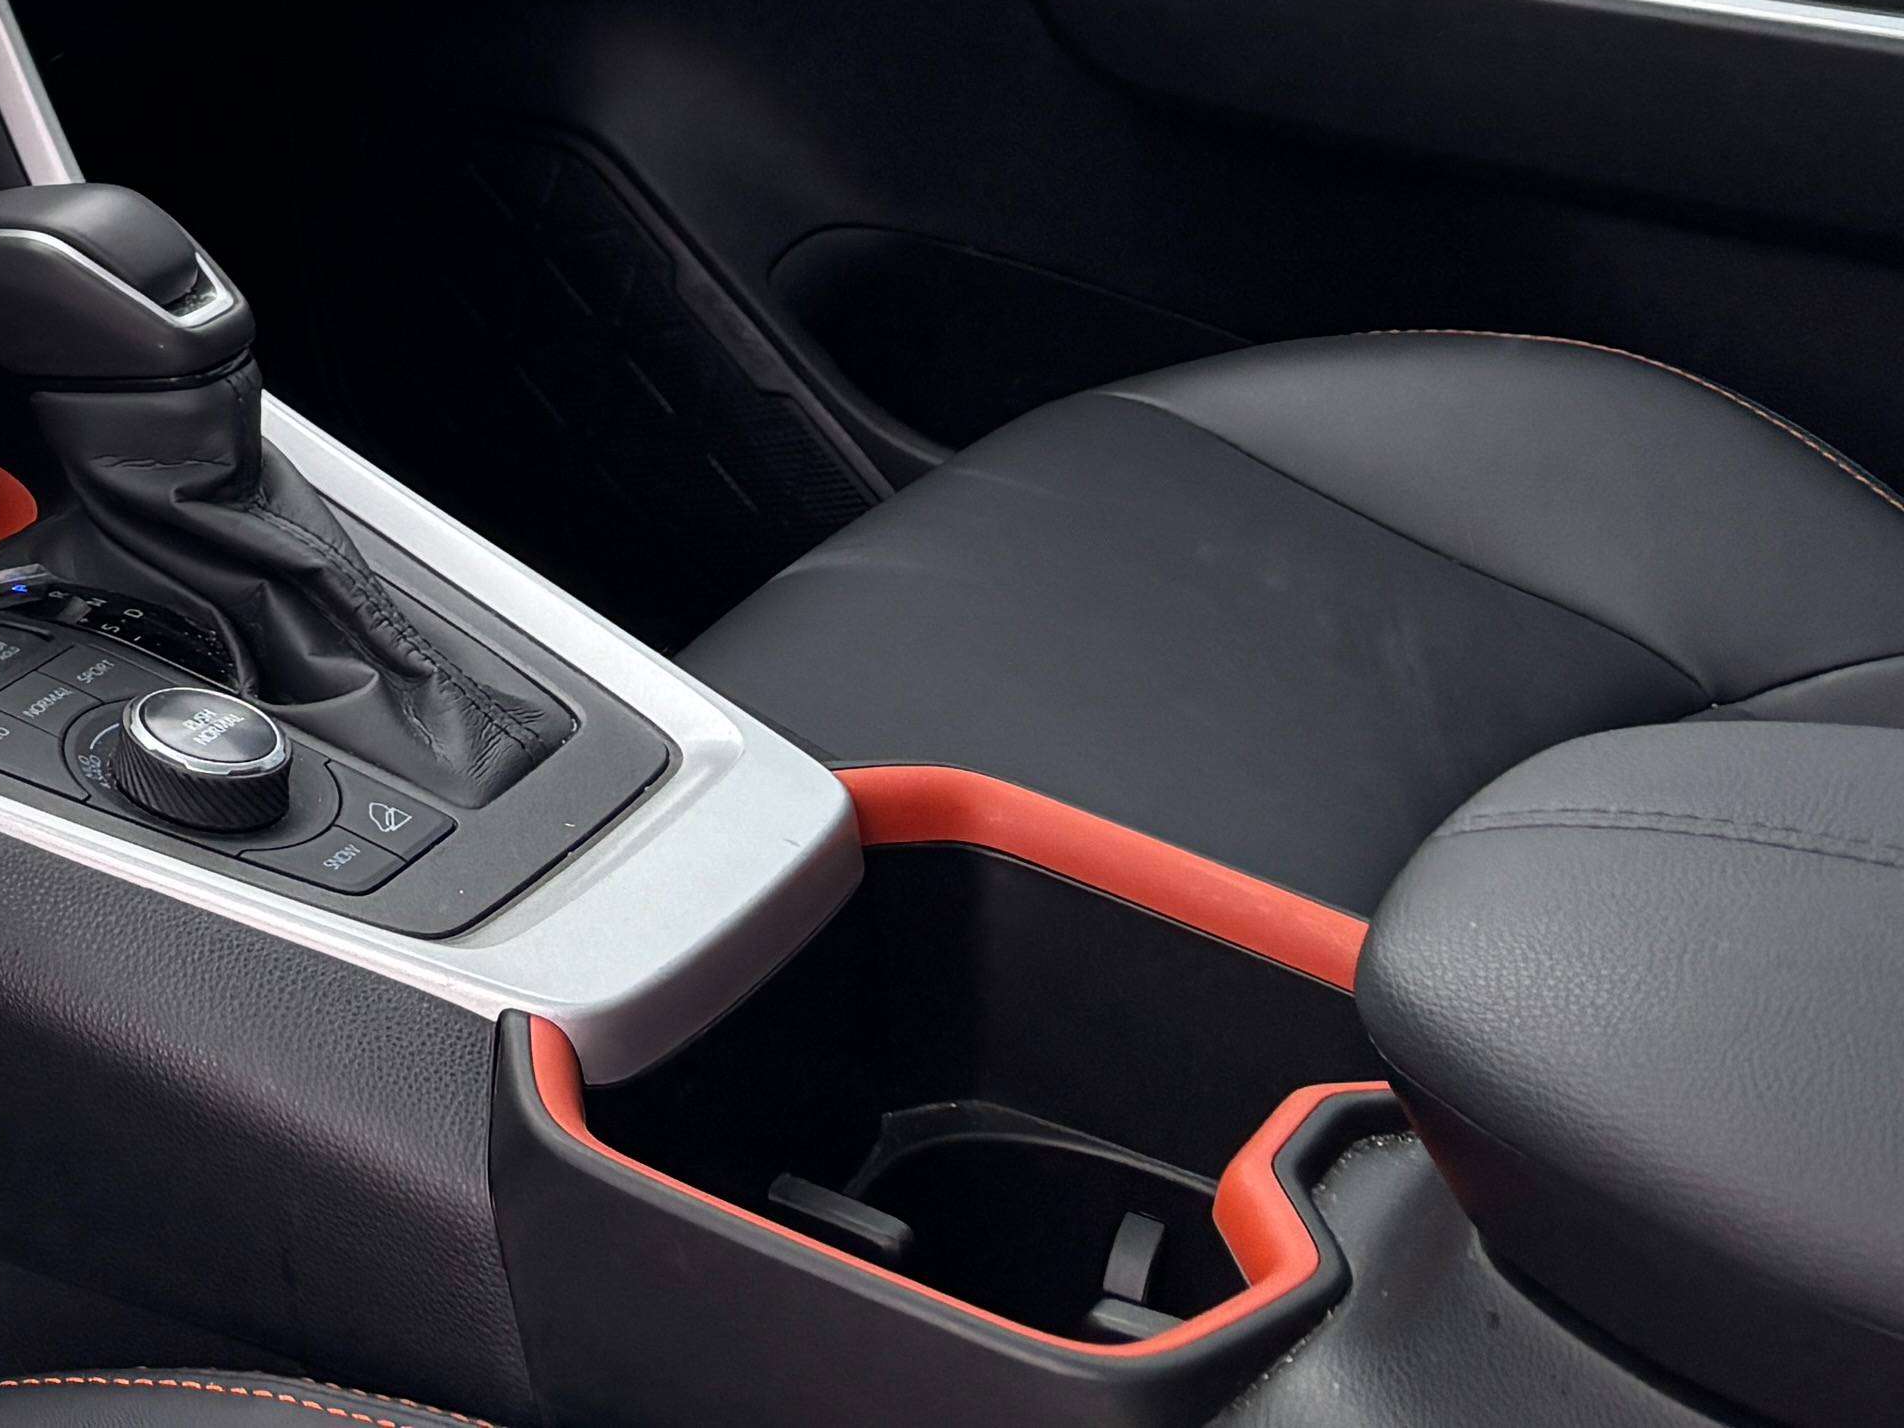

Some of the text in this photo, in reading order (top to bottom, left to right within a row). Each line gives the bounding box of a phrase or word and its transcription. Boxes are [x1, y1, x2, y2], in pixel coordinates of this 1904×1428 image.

[123, 608, 144, 619] D
[76, 659, 115, 685] SPORT
[22, 687, 73, 720] NORMAL
[181, 707, 217, 732] PUSH
[193, 714, 245, 746] NORMAL
[322, 843, 362, 871] SNOW
